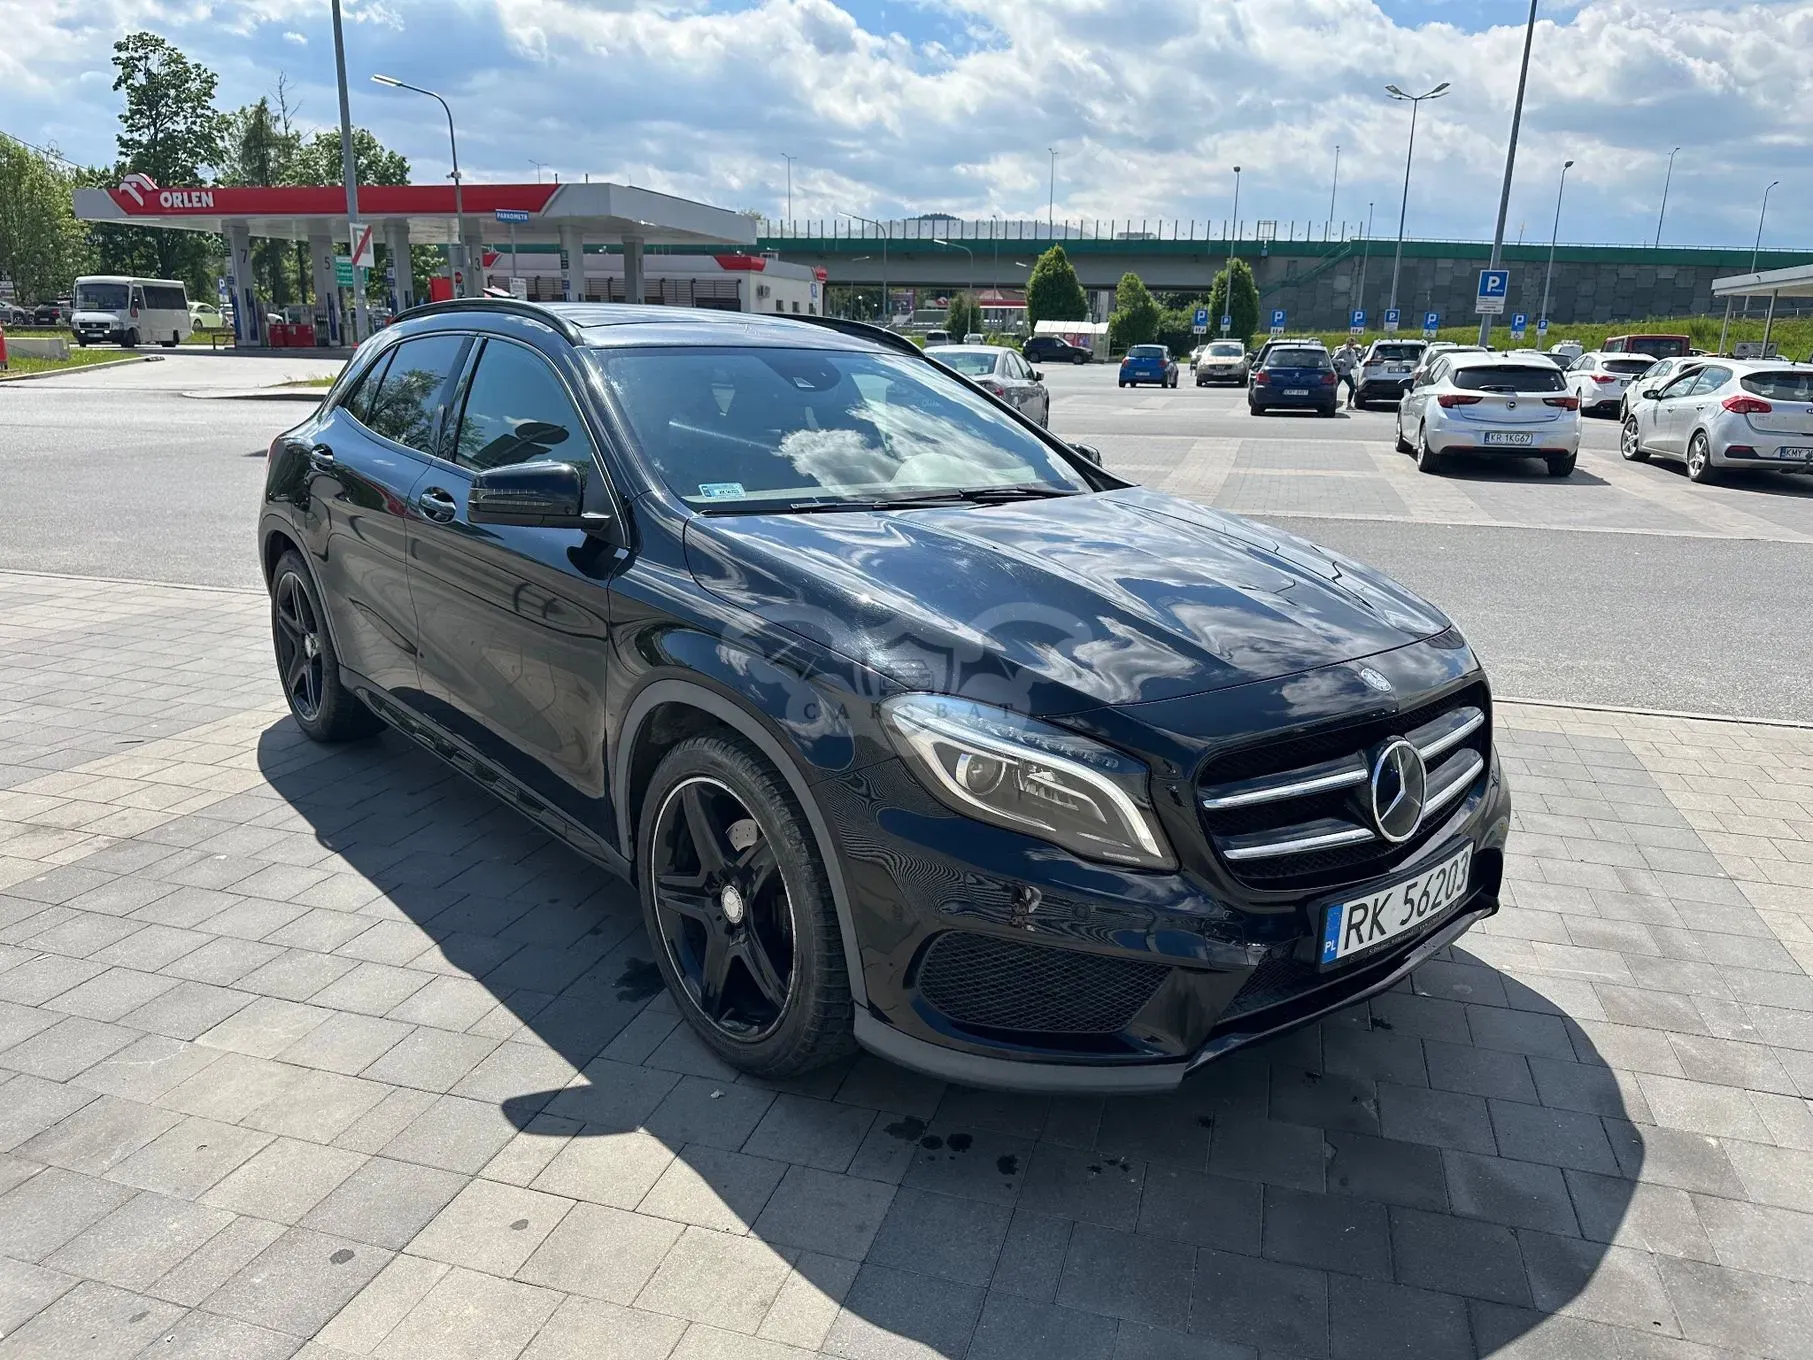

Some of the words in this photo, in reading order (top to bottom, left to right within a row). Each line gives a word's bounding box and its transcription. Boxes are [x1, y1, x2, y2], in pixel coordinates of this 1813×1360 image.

[160, 191, 214, 208] ORLEN
[240, 248, 248, 264] 7
[324, 255, 331, 270] 5
[475, 257, 481, 271] 3
[1487, 276, 1500, 292] P
[1197, 310, 1206, 321] P
[1274, 311, 1283, 322] P
[1354, 311, 1363, 322] P
[1389, 312, 1396, 321] P
[1427, 313, 1437, 324] P
[1514, 314, 1525, 326] P
[1490, 433, 1503, 442] KR
[1506, 434, 1530, 443] 1KG67
[1786, 449, 1802, 457] KMY
[1344, 892, 1393, 950] RK
[1400, 851, 1470, 926] 56203
[1324, 940, 1336, 953] PL
